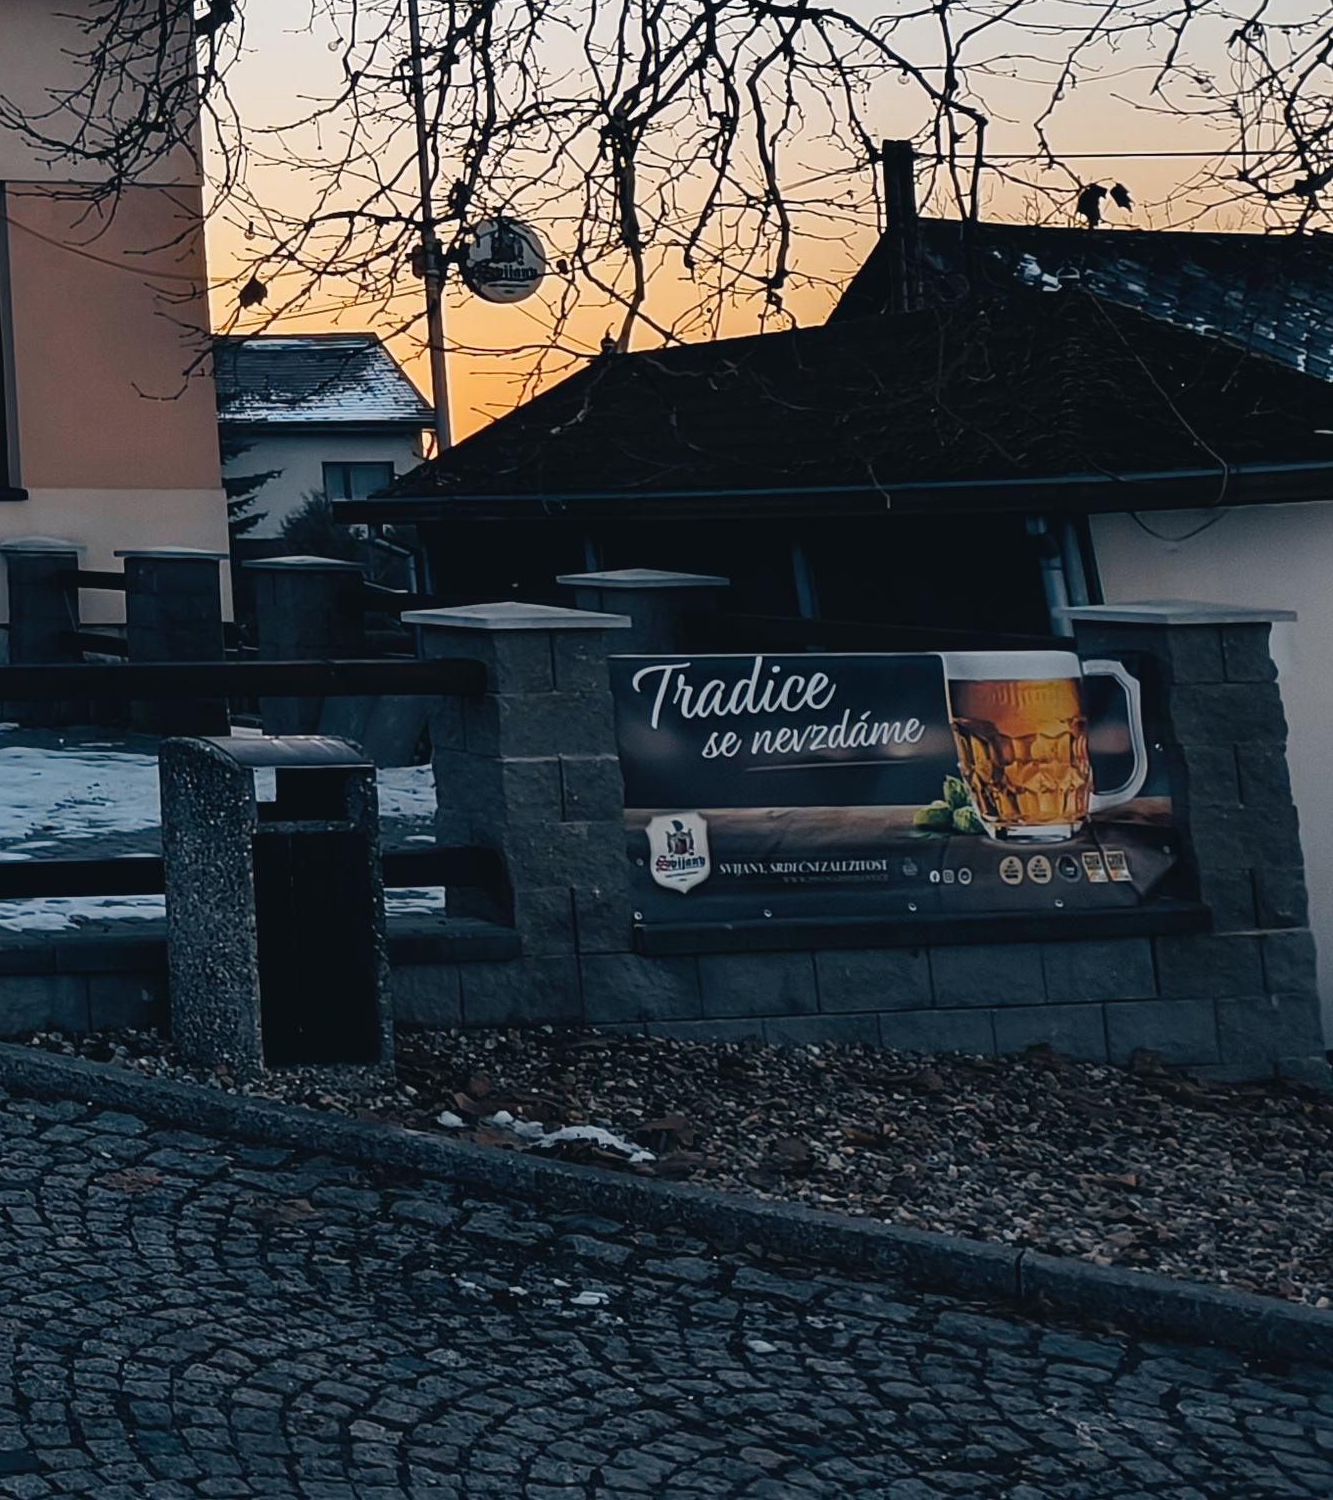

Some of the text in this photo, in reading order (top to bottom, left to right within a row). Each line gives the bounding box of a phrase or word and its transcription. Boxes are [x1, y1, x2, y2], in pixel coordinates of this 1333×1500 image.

[632, 656, 836, 729] Tradice
[701, 708, 926, 759] se nevzdáme
[656, 855, 706, 872] Svijany
